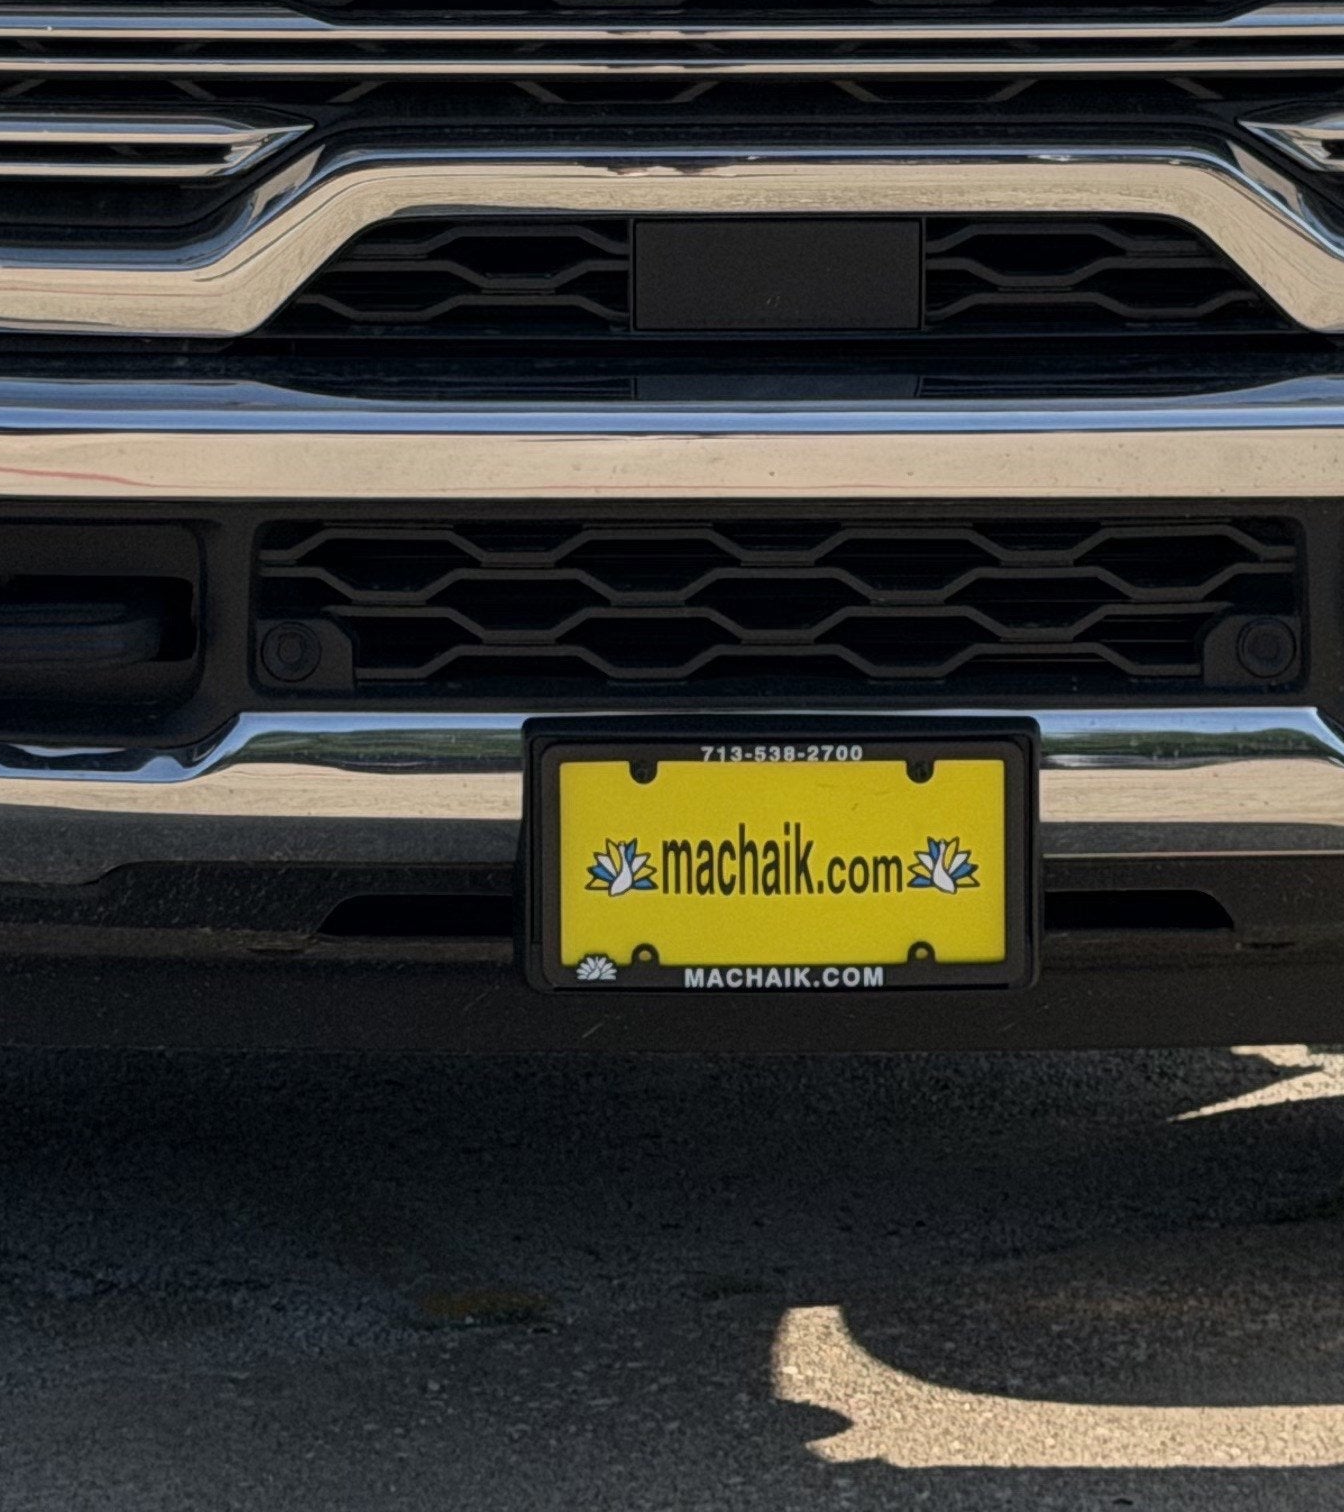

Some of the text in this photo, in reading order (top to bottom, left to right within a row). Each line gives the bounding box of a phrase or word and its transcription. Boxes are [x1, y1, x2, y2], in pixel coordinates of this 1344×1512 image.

[700, 744, 864, 763] 713-538-2700
[662, 821, 903, 896] machaik.com
[683, 967, 884, 988] MACHAIK.COM
